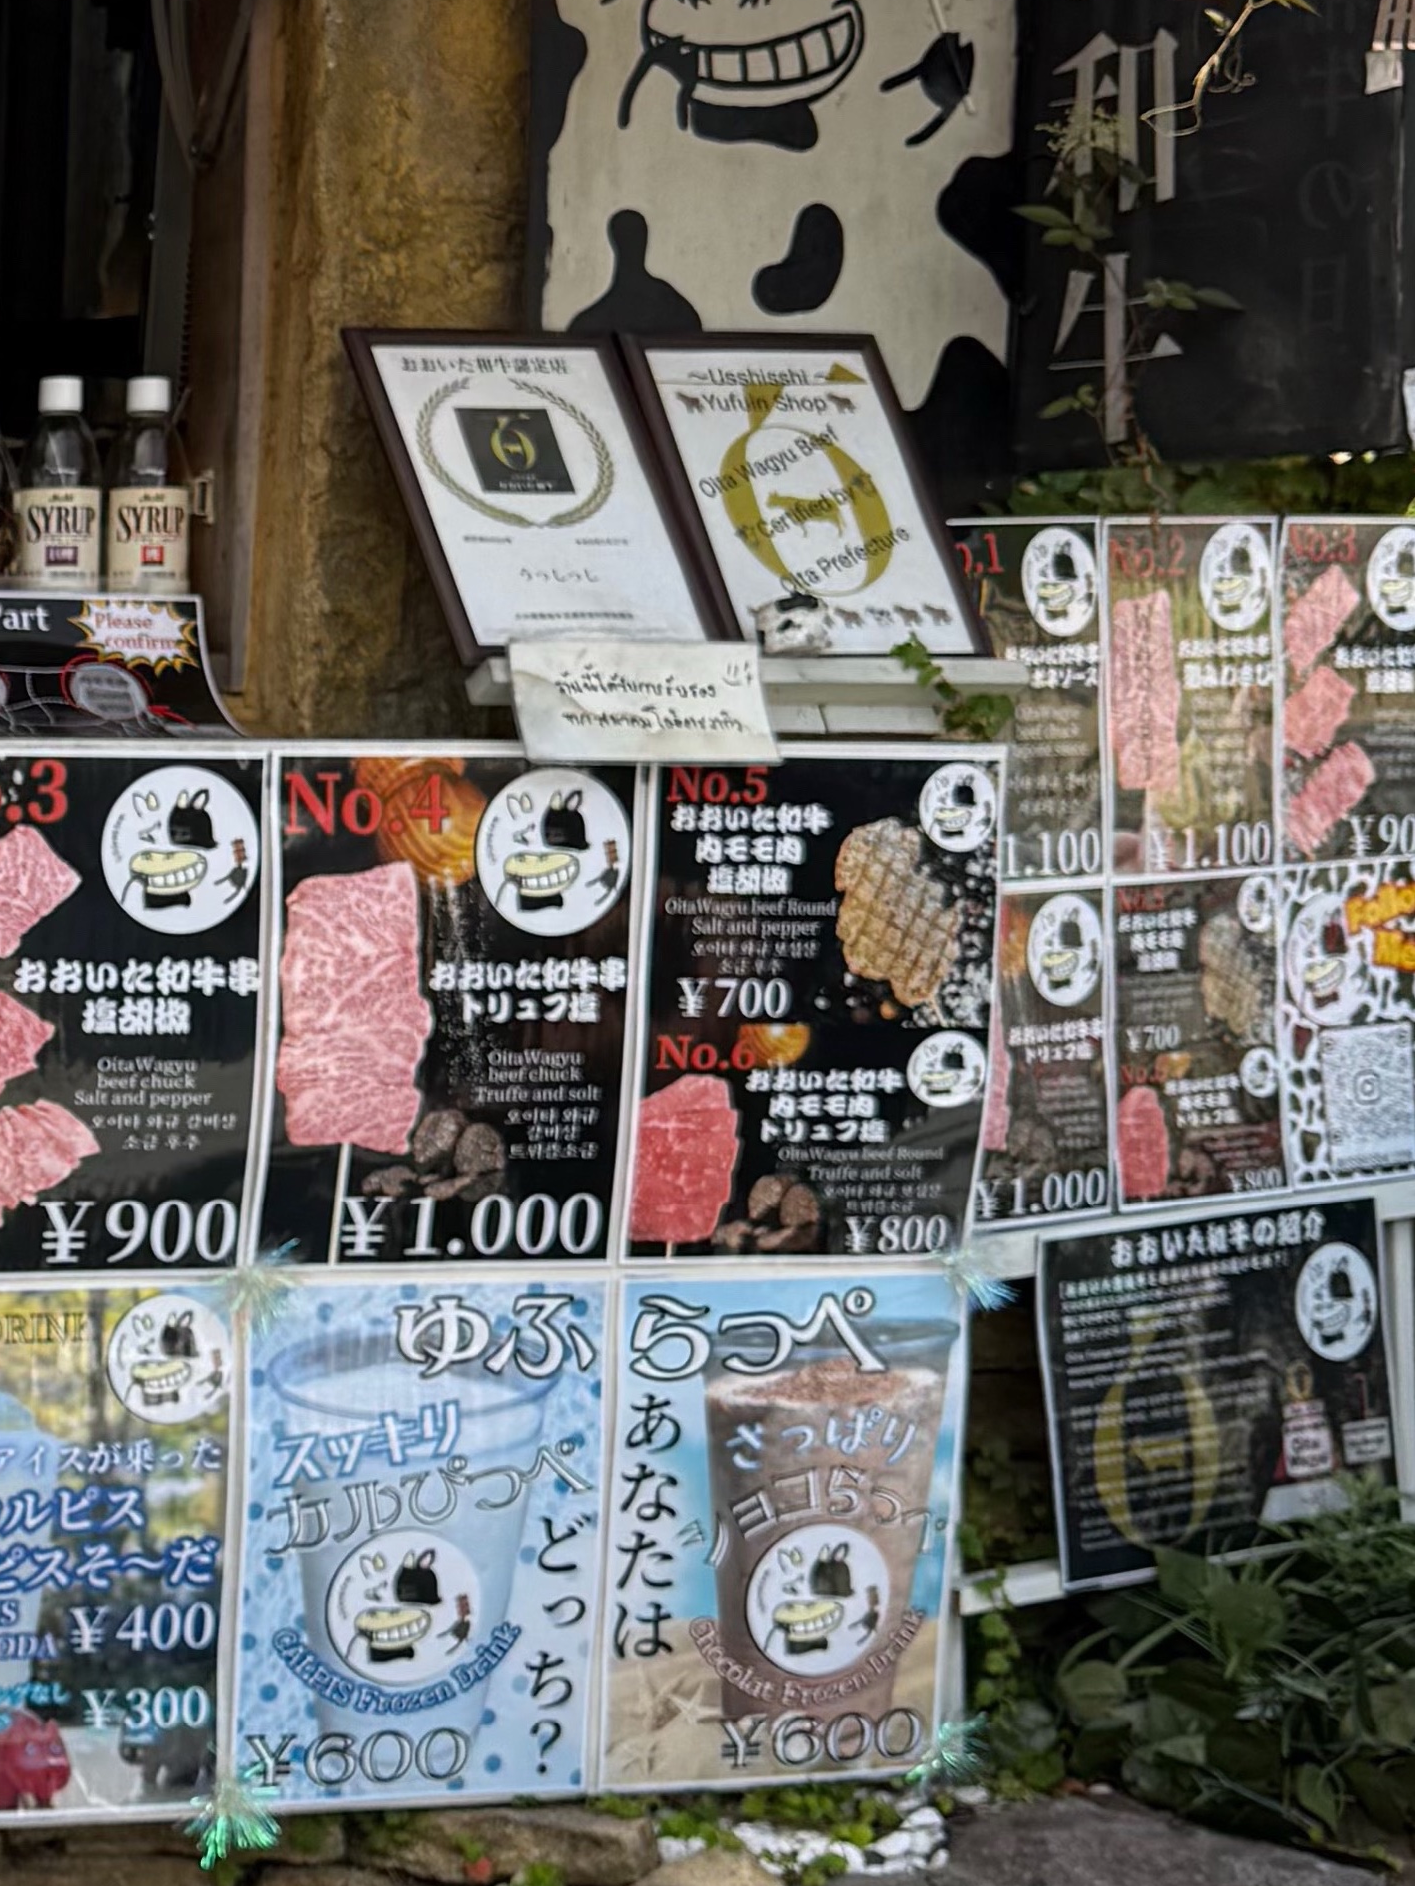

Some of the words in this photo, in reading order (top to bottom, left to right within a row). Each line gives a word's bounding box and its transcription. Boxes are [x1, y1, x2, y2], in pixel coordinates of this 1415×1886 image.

[700, 393, 770, 413] Yufuin
[772, 393, 827, 418] Shop
[697, 466, 737, 499] Oita
[738, 443, 796, 484] Wagyu
[26, 503, 97, 544] SYRUP
[116, 503, 186, 544] SYRUP
[755, 494, 834, 540] Certified
[833, 484, 856, 511] by
[818, 523, 913, 578] Prefecture
[93, 612, 154, 629] Please
[103, 632, 176, 651] confirm
[285, 771, 450, 836] No.4
[666, 766, 769, 803] No.5
[670, 801, 835, 836] おおいた和牛
[13, 956, 263, 997] おおいた和牛串
[429, 956, 628, 993] おおいた和牛串
[81, 996, 191, 1036] 塩胡椒
[462, 991, 601, 1025] トリュフ塩
[655, 1034, 757, 1071] No.6
[74, 1089, 107, 1106] Salt
[111, 1089, 144, 1106] and
[149, 1091, 213, 1108] pepper
[745, 1066, 906, 1094] おおいた和牛
[396, 1293, 594, 1378] ゆふ
[273, 1397, 463, 1489] スッキリ
[727, 1410, 919, 1471] さっぱり
[611, 1391, 682, 1662] あなたは
[351, 1669, 457, 1715] Frozen
[452, 1619, 521, 1687] Drink
